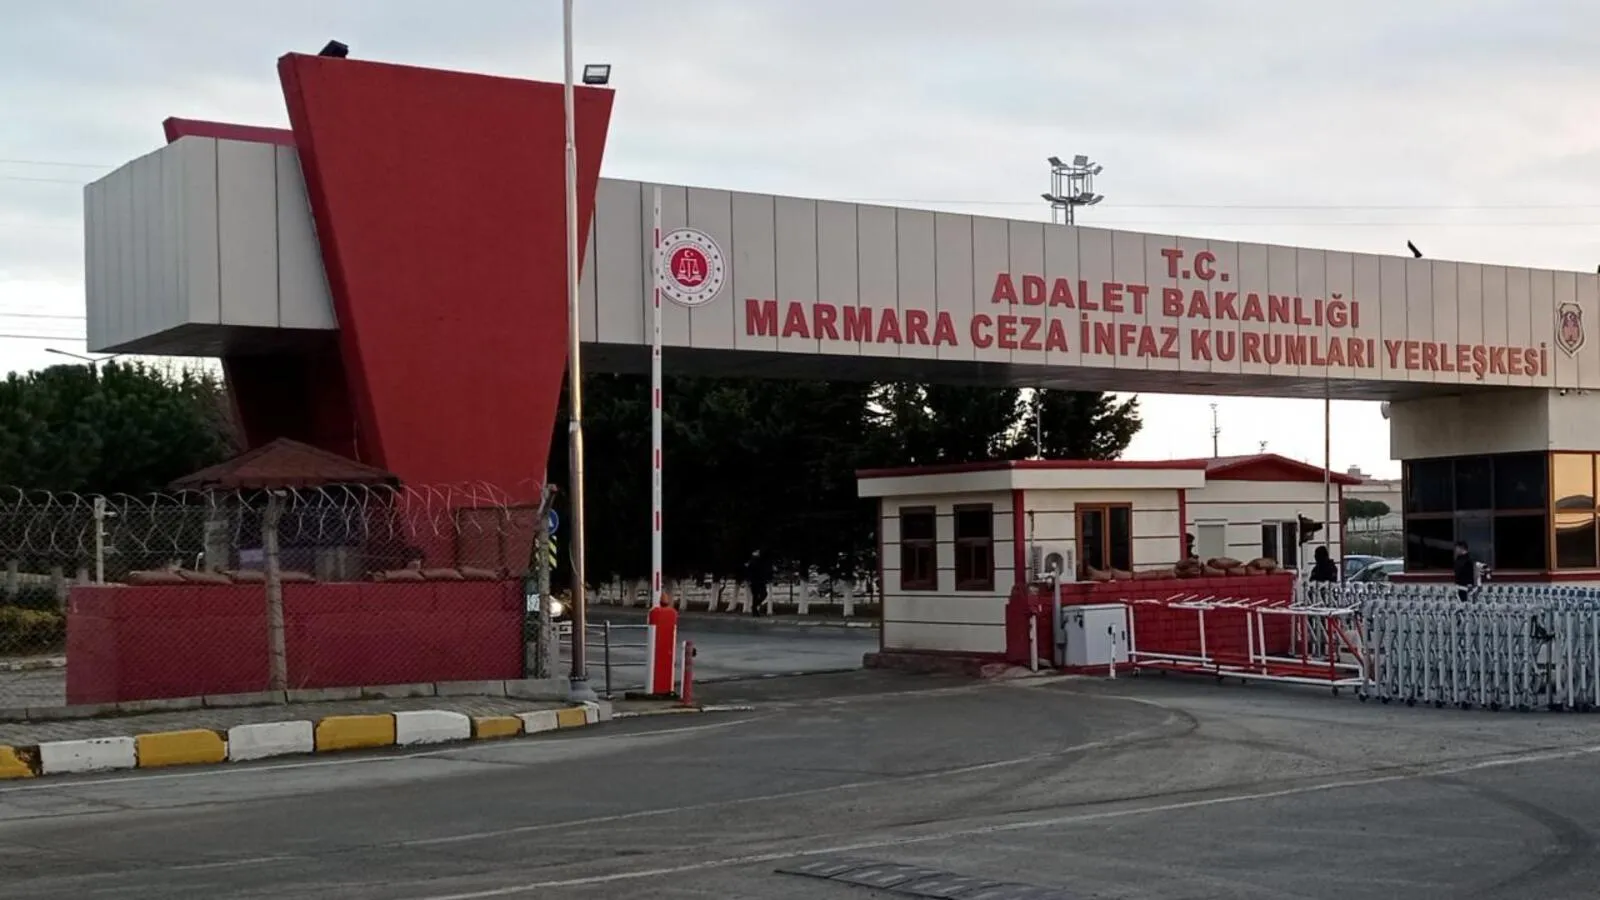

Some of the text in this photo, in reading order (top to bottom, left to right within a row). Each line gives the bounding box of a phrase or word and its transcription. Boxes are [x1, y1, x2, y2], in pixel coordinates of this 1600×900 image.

[1161, 248, 1229, 281] T.C.
[991, 273, 1360, 328] ADALET BAKANLIĞI
[745, 298, 1548, 380] MARMARA CEZA İNFAZ KURUMLARI YERLEŞKESİ
